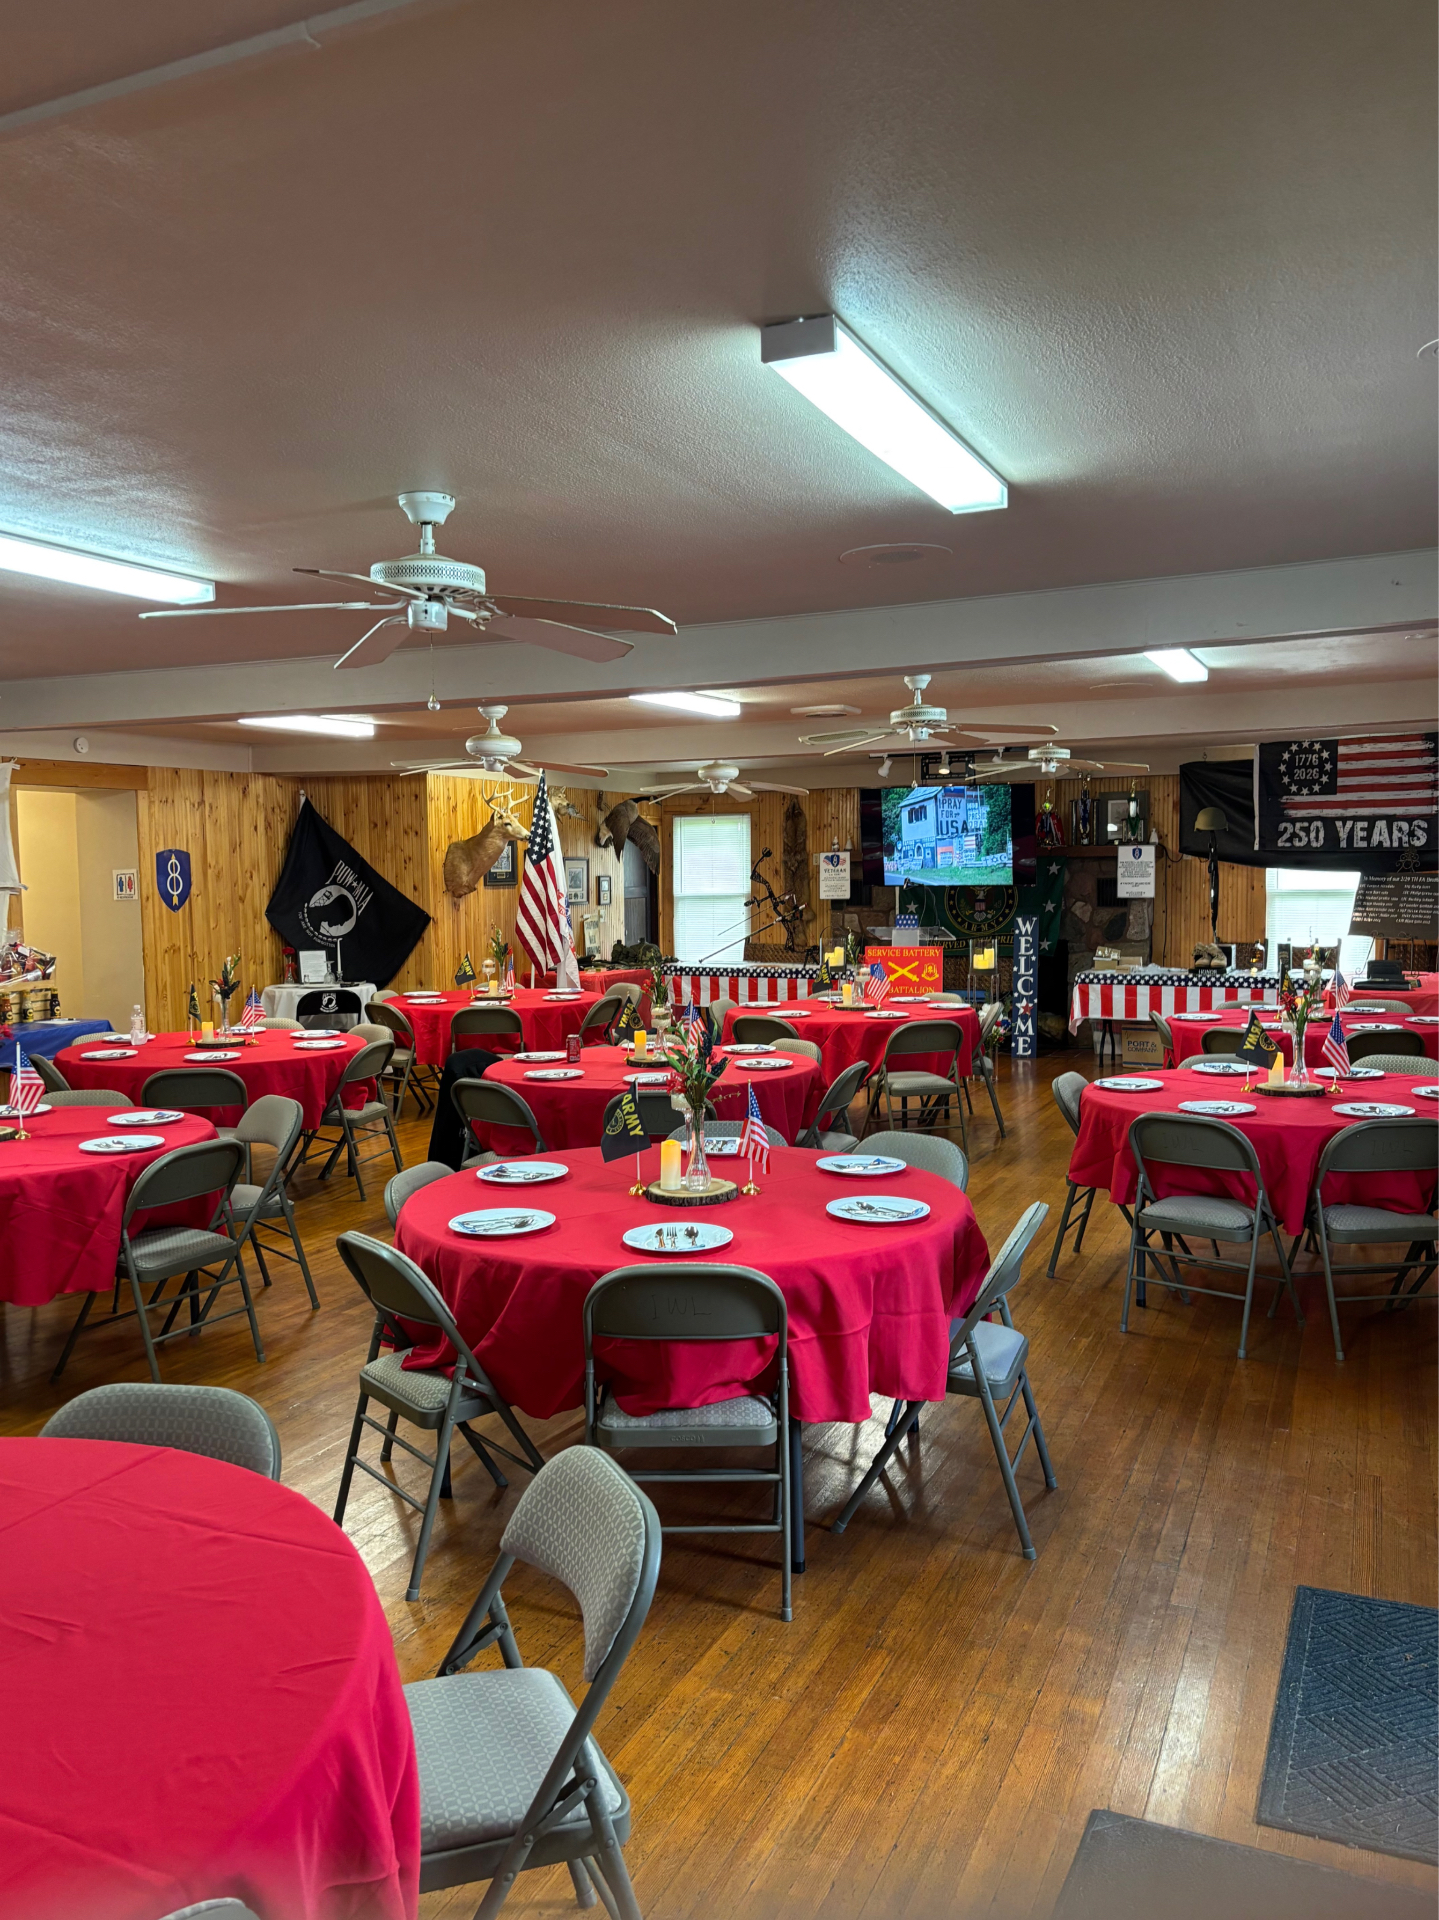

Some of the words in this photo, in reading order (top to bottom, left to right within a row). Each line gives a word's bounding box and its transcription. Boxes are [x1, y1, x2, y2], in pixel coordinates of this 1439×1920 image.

[1295, 754, 1319, 767] 1776
[1293, 768, 1320, 780] 2026
[942, 799, 963, 810] PRAY
[940, 810, 954, 819] FOR
[940, 820, 969, 835] USA
[1277, 820, 1325, 848] 250
[1335, 819, 1428, 848] YEARS
[325, 859, 357, 888] POW
[352, 880, 374, 917] MIA
[961, 919, 998, 932] ARMY
[867, 948, 901, 957] SERVICE
[902, 948, 941, 957] BATTERY
[888, 986, 935, 994] BATTALION
[623, 1093, 645, 1137] ARMY
